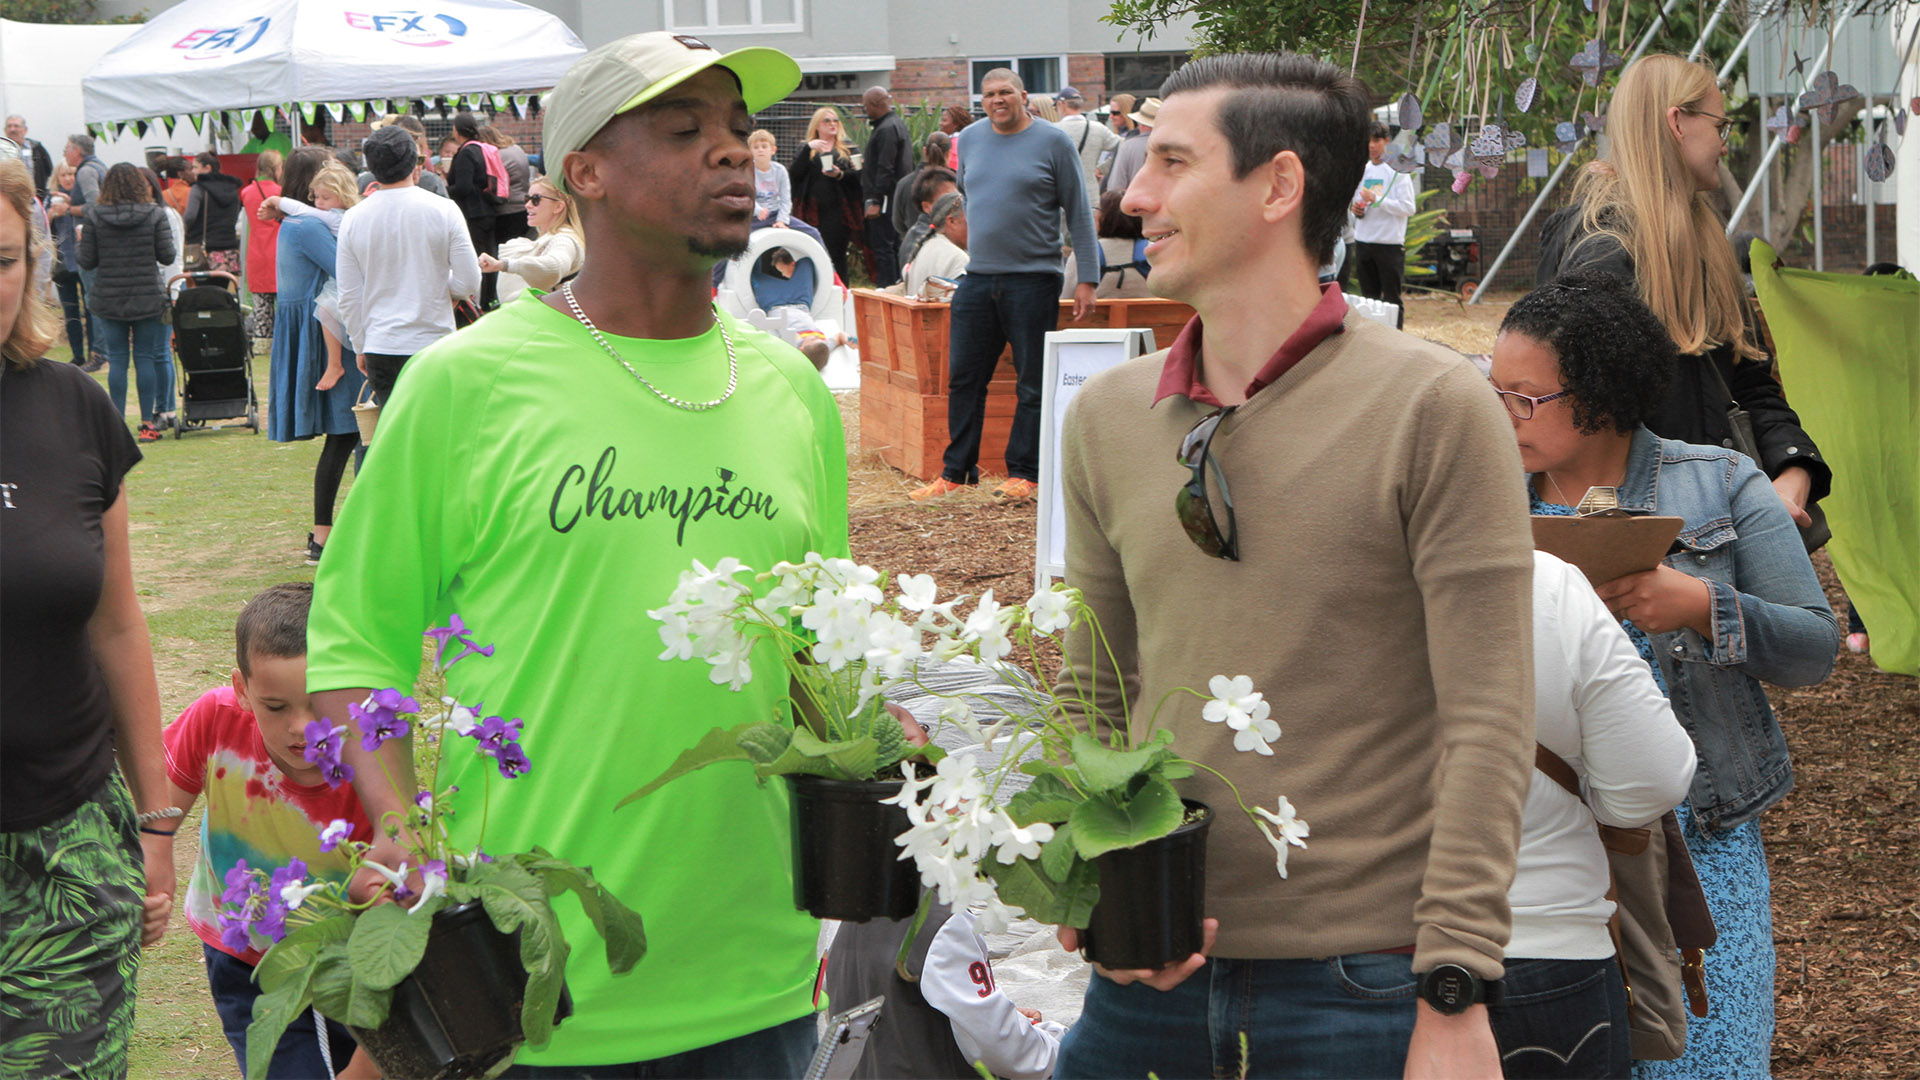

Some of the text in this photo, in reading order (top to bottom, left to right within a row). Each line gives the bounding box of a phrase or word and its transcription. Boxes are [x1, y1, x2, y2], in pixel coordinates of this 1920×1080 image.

[343, 11, 428, 32] EFX
[794, 73, 857, 91] URT
[549, 446, 780, 547] Champion
